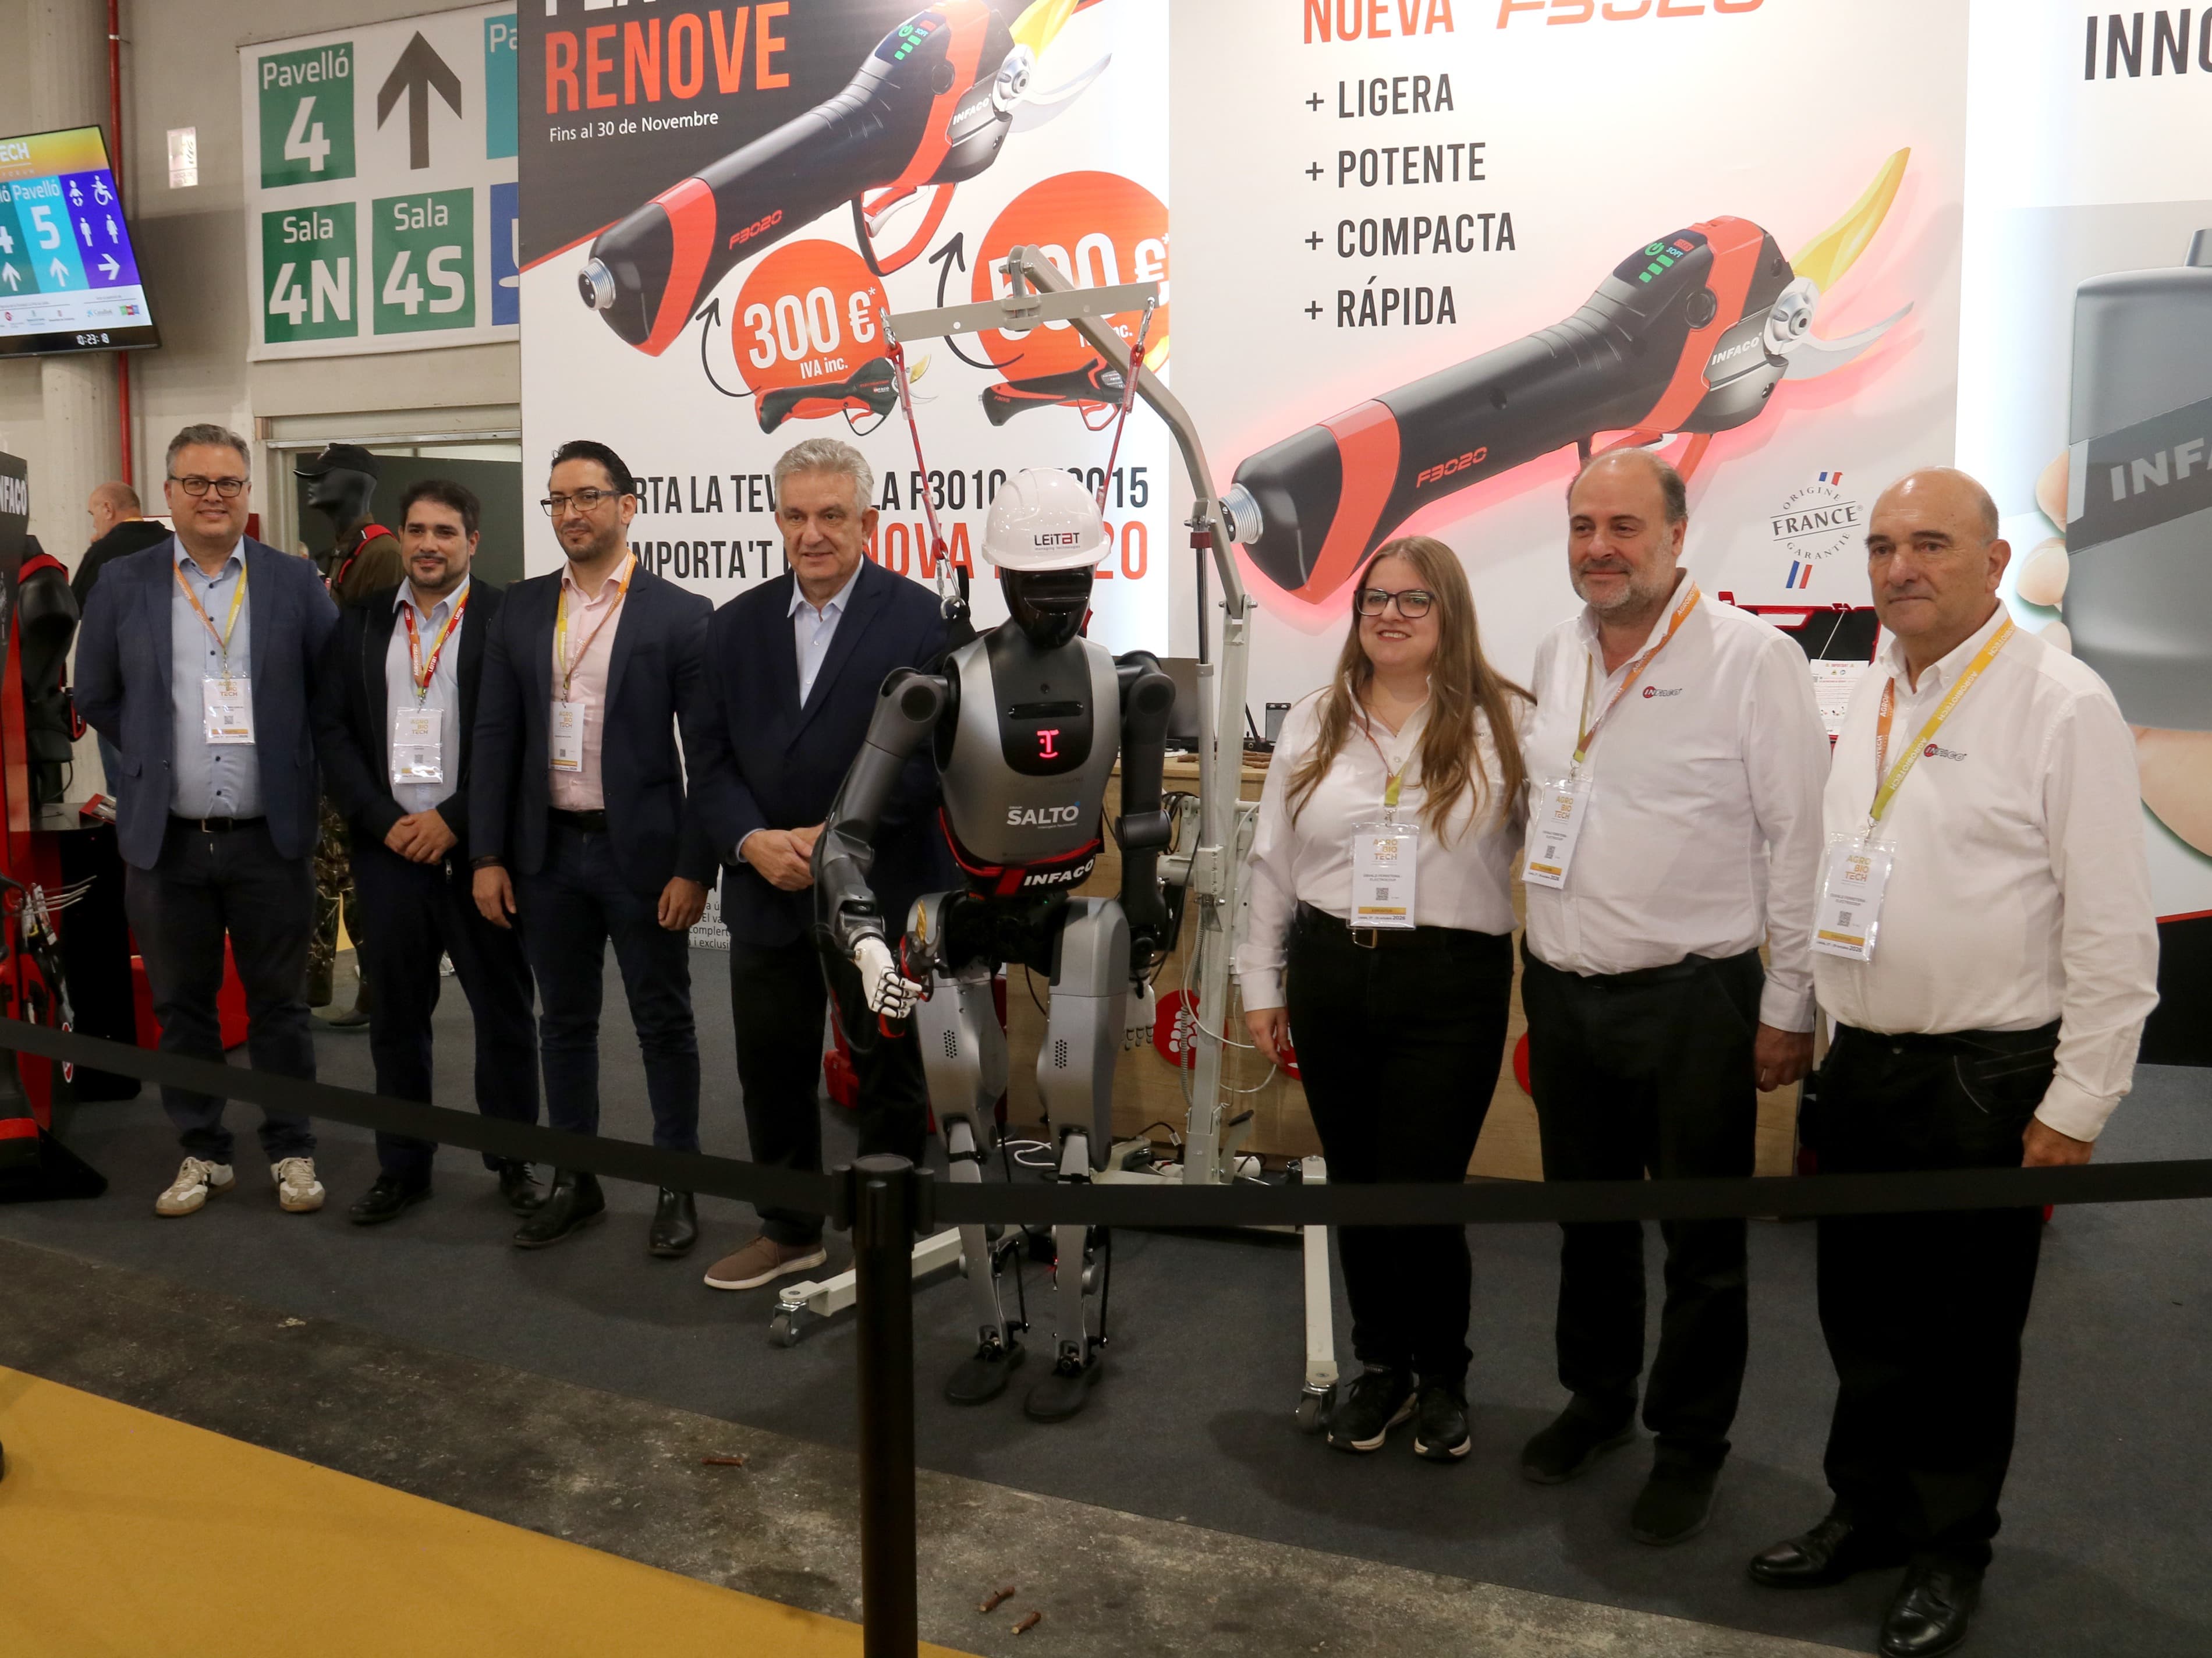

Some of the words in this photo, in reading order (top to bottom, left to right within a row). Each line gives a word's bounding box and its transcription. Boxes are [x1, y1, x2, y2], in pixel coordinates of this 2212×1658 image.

[263, 52, 349, 90] Pavelló
[545, 1, 790, 114] RENOVE
[1338, 73, 1454, 118] LIGERA
[284, 97, 331, 172] 4
[550, 126, 576, 142] Fins
[580, 123, 593, 139] al
[597, 121, 614, 137] 30
[618, 118, 637, 134] de
[641, 111, 719, 132] Novembre
[0, 142, 30, 162] ECH
[1338, 142, 1486, 188] POTENTE
[12, 179, 60, 200] Pavelló
[31, 205, 61, 249] 5
[283, 215, 334, 245] Sala
[394, 203, 449, 232] Sala
[729, 210, 782, 250] F3020
[1337, 212, 1515, 258] COMPACTA
[1665, 247, 1684, 258] SOFT
[269, 258, 350, 326] 4N
[382, 245, 466, 316] 4S
[1337, 275, 1456, 328] RÁPIDA
[743, 286, 840, 369] 300
[800, 360, 822, 380] IVA
[825, 357, 848, 374] inc.
[1416, 446, 1488, 488] F3020
[2110, 437, 2212, 502] INF
[0, 475, 27, 516] NFACO
[634, 476, 682, 515] RTA
[691, 474, 723, 513] LA
[1783, 487, 1841, 510] ORIGINE
[627, 540, 772, 579] MPORTA'T
[1787, 532, 1851, 559] GARANTIE
[1006, 805, 1079, 826] SALTO
[1555, 811, 1570, 820] TECH
[1557, 796, 1574, 805] AGRO
[1023, 858, 1094, 886] INFACO
[1845, 871, 1867, 883] TECH
[1846, 855, 1871, 865] AGRO
[1854, 864, 1869, 873] BIO
[700, 938, 729, 950] exclusi
